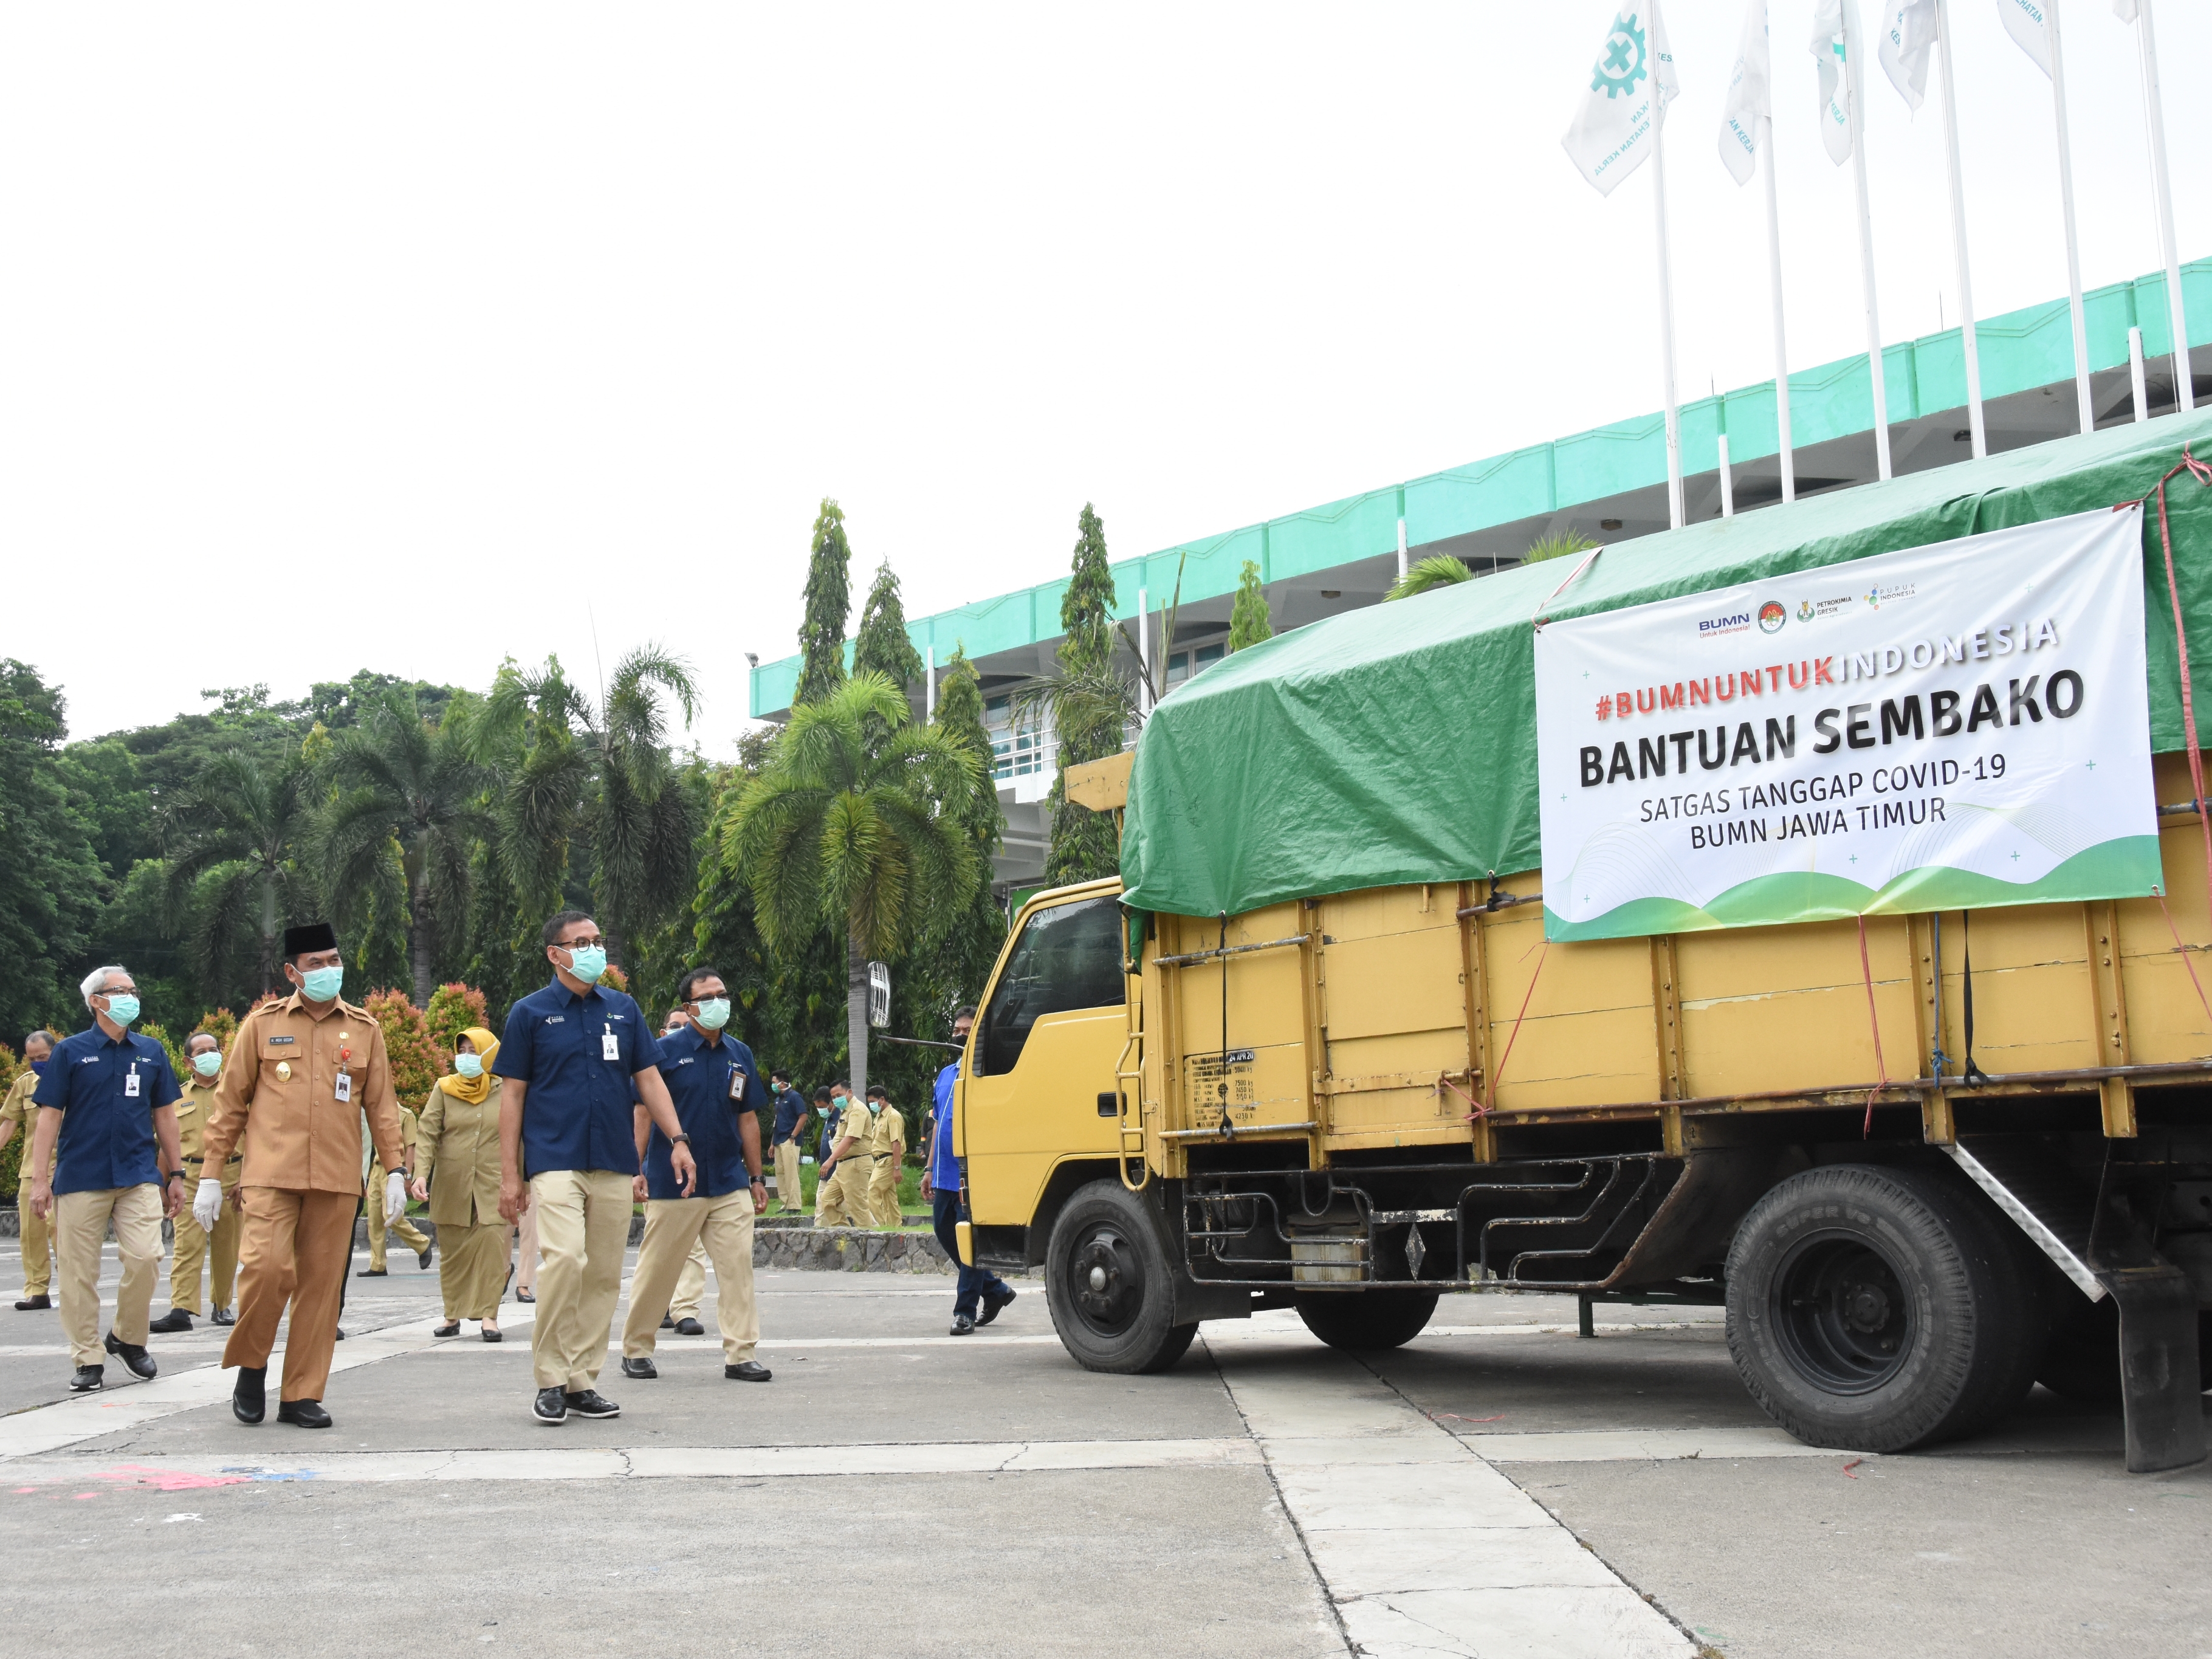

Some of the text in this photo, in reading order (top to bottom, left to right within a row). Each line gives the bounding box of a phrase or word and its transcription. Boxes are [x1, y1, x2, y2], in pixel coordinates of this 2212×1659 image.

[1736, 129, 1754, 154] KERJA
[1880, 583, 1915, 595] PUPUK
[1880, 589, 1915, 601] INDONESIA
[1816, 596, 1852, 608] PETROKIMIA
[1817, 607, 1838, 616] GRESIK
[1699, 613, 1750, 631] BUMN
[1719, 624, 1750, 634] Indonesia!
[1595, 617, 2059, 721] #BUMNUNTUKINDONESIA
[1580, 669, 2084, 788] BANTUAN SEMBAKO
[1640, 753, 2007, 823] SATGAS TANGGAP COVID-19
[1691, 797, 1946, 850] BUMN JAWA TIMUR
[1237, 1053, 1246, 1061] APR
